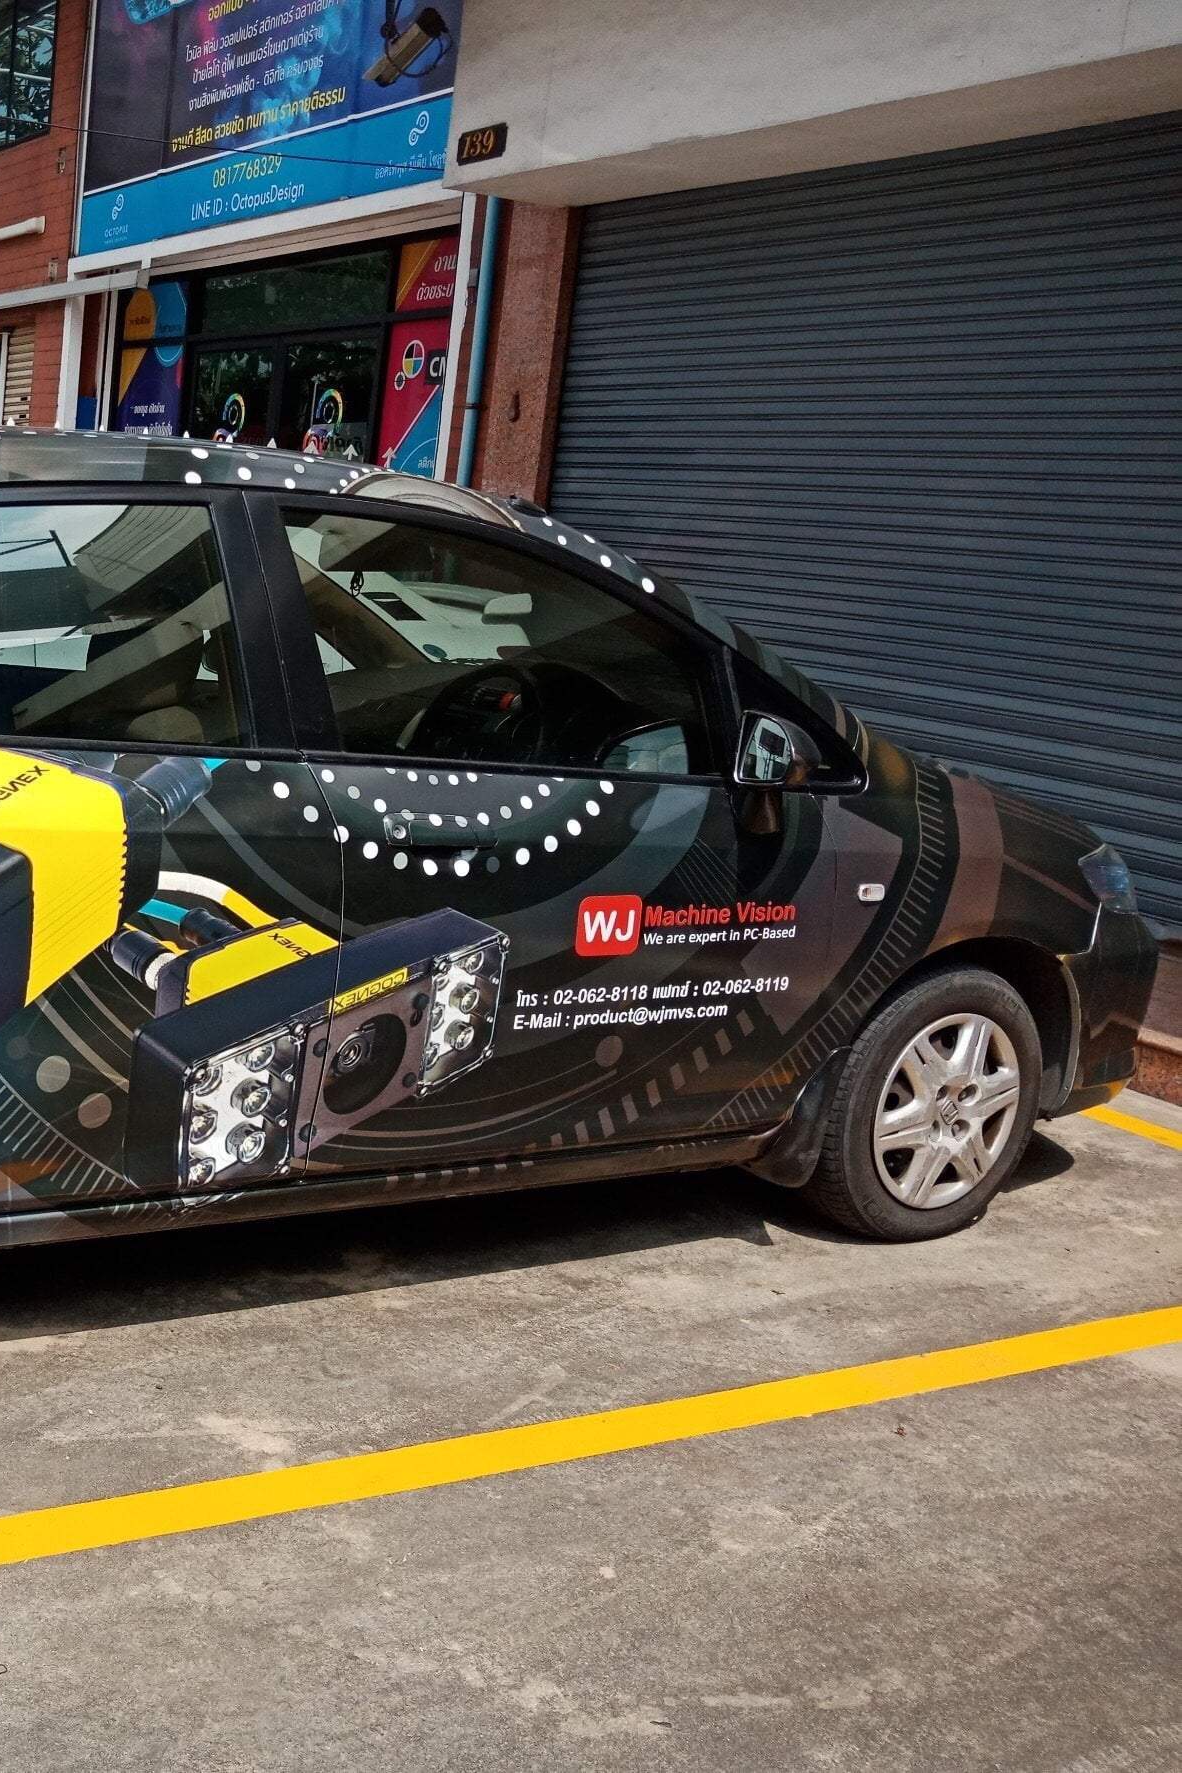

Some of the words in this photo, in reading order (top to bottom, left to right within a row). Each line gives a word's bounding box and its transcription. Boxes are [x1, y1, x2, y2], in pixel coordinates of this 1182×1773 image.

[461, 128, 495, 159] 139
[212, 152, 283, 189] 0817768329
[191, 200, 211, 222] LINE
[212, 198, 224, 216] ID
[231, 181, 305, 212] OctopusDesign
[583, 909, 636, 944] WJ
[644, 902, 731, 928] Machine
[736, 900, 797, 924] Vision
[643, 932, 664, 946] We
[666, 932, 686, 945] are
[688, 930, 728, 947] expert
[729, 928, 741, 942] in
[743, 925, 797, 941] PC-Based
[516, 989, 539, 1008] โทร
[553, 984, 648, 1006] 02-062-8118
[652, 980, 691, 1001] แฟกซ์
[702, 976, 790, 997] 02-062-8119
[513, 1012, 562, 1031] E-Mail
[573, 1004, 729, 1030] product@wjmvs.com
